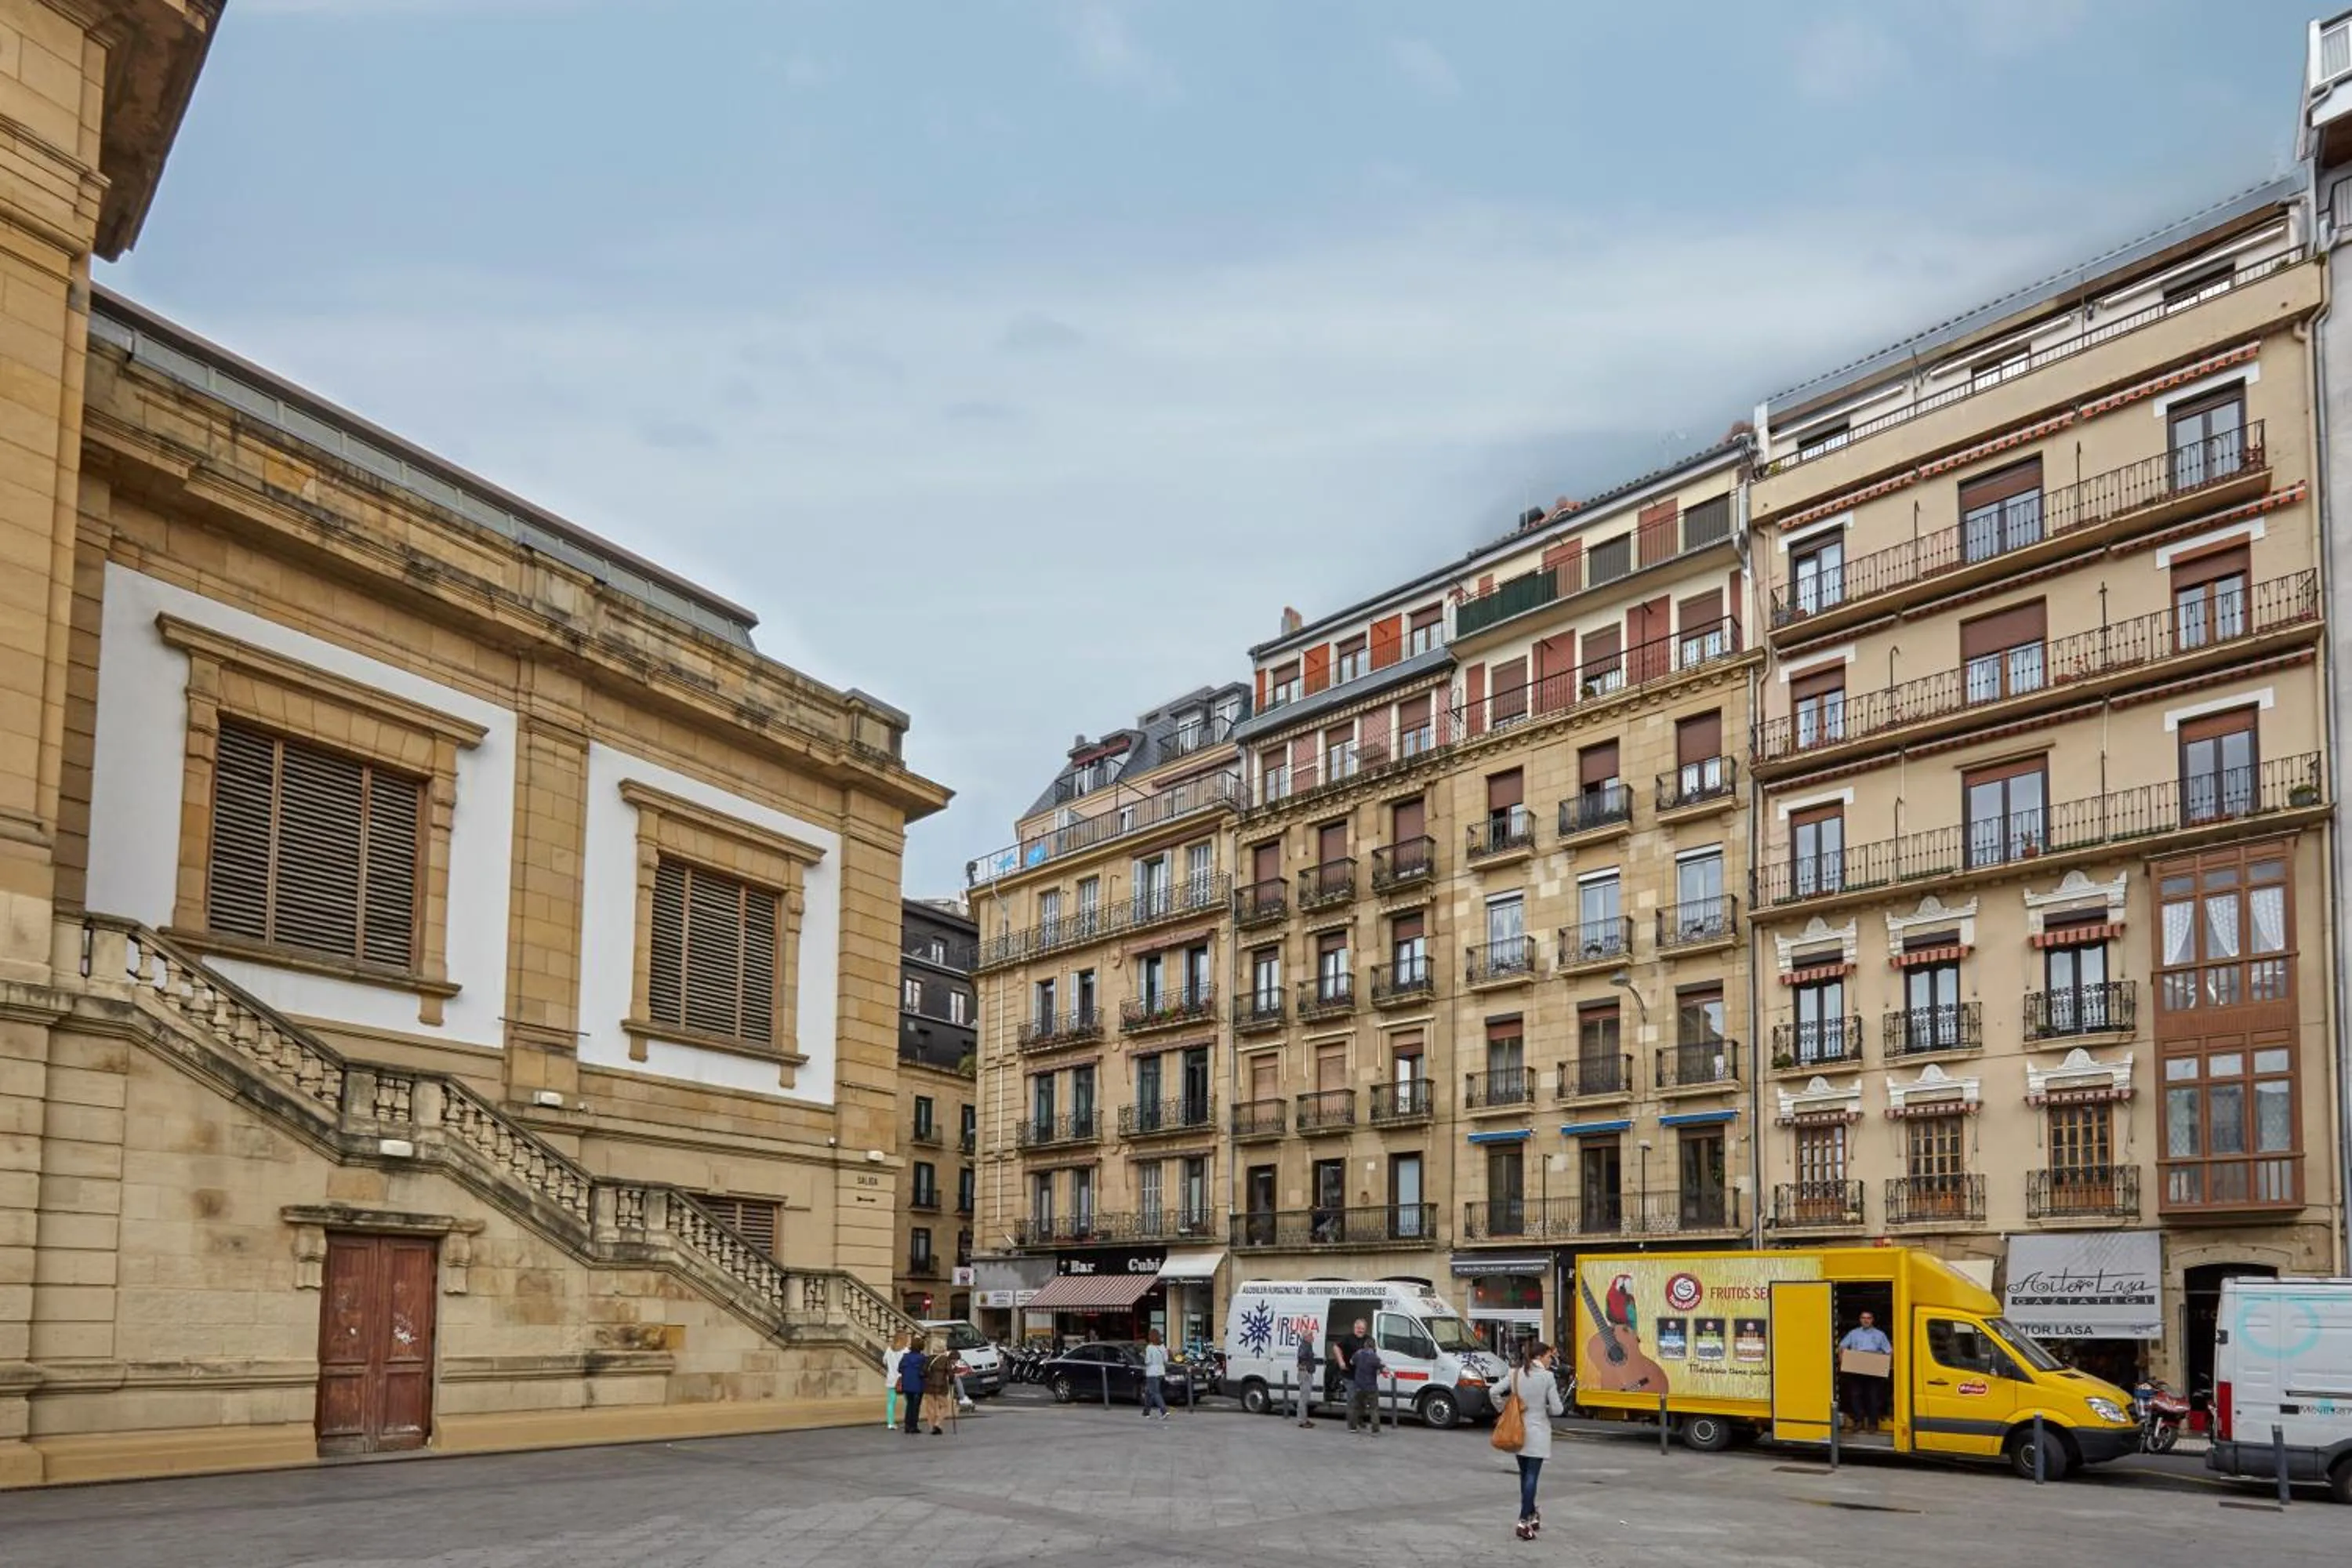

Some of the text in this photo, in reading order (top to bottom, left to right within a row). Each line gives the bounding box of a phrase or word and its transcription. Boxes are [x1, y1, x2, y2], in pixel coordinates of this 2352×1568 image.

[1070, 1260, 1096, 1273] Bar
[1710, 1286, 1770, 1300] FRUTOS SE
[2055, 1325, 2094, 1335] LASA
